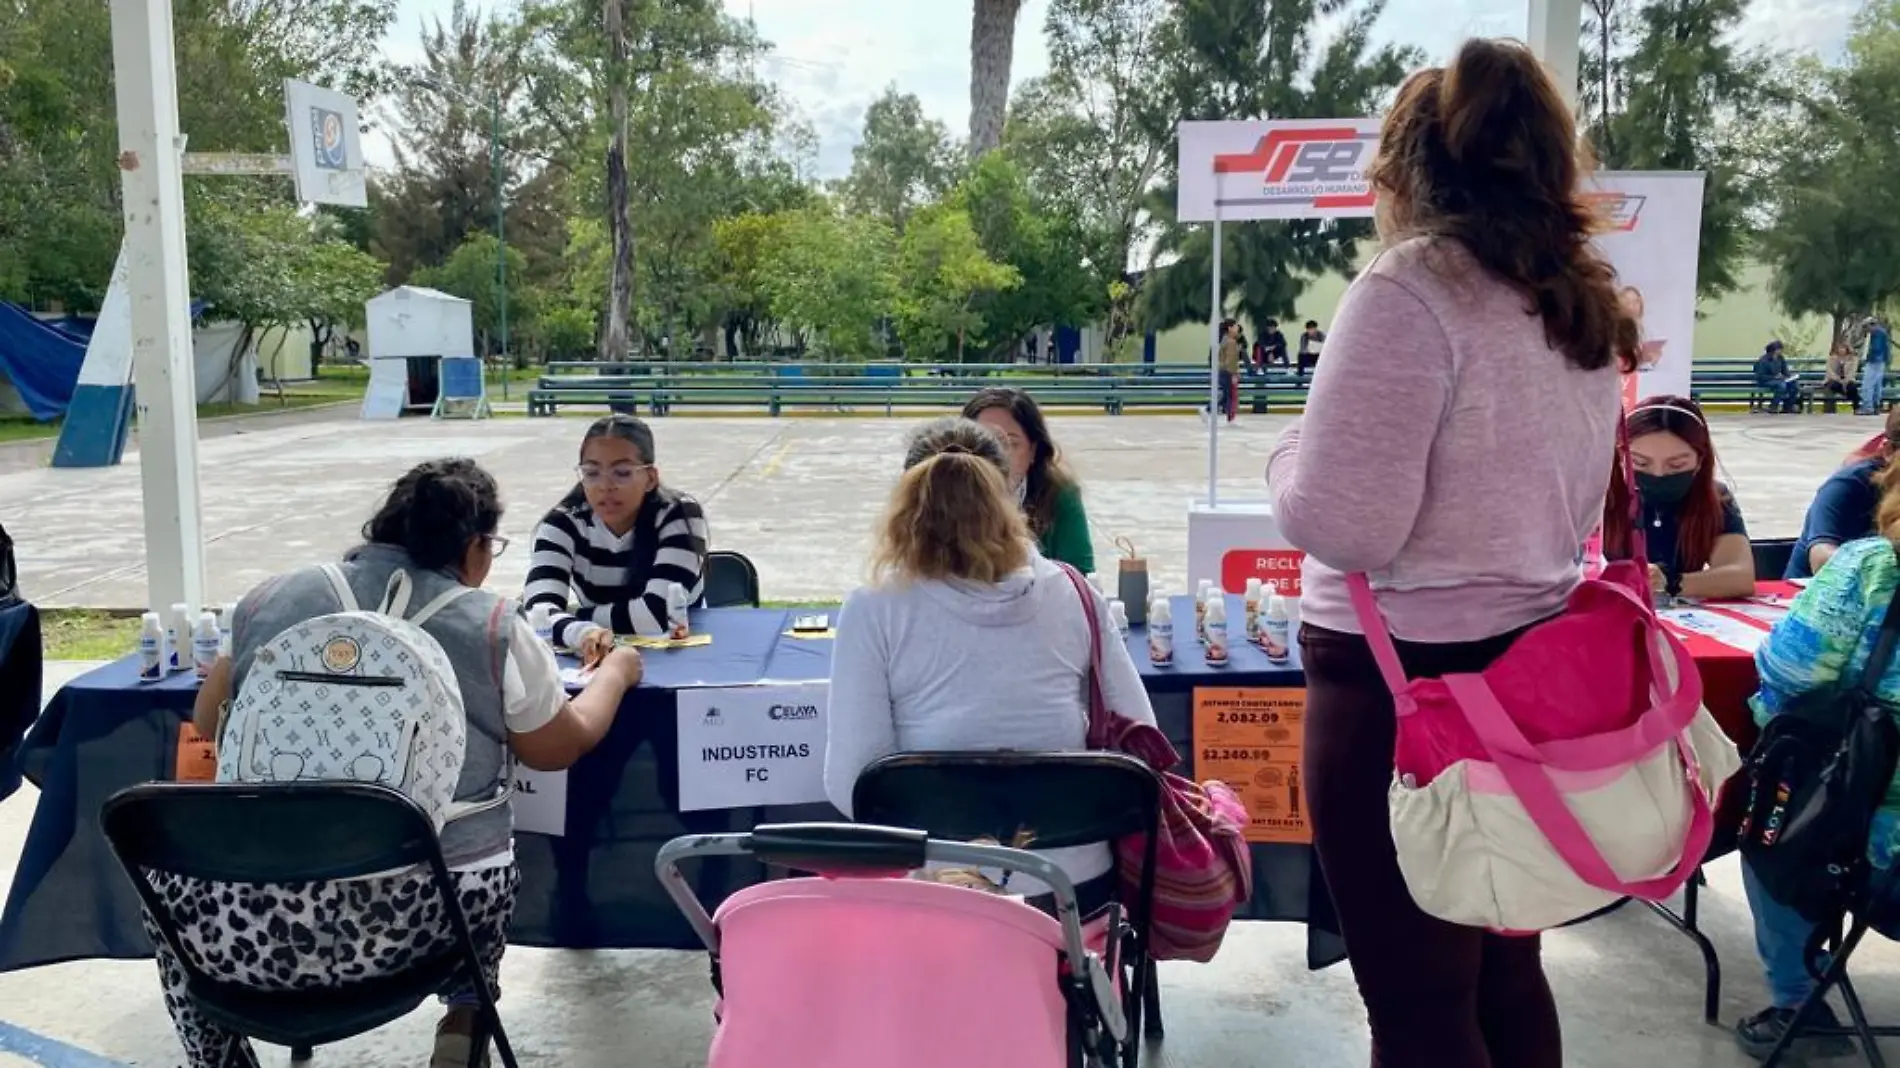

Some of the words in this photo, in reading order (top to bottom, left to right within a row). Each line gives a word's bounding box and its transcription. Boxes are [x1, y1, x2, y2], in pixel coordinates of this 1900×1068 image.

[1263, 185, 1323, 196] DESARROLLO
[702, 743, 810, 762] INDUSTRIAS
[746, 767, 769, 783] FC
